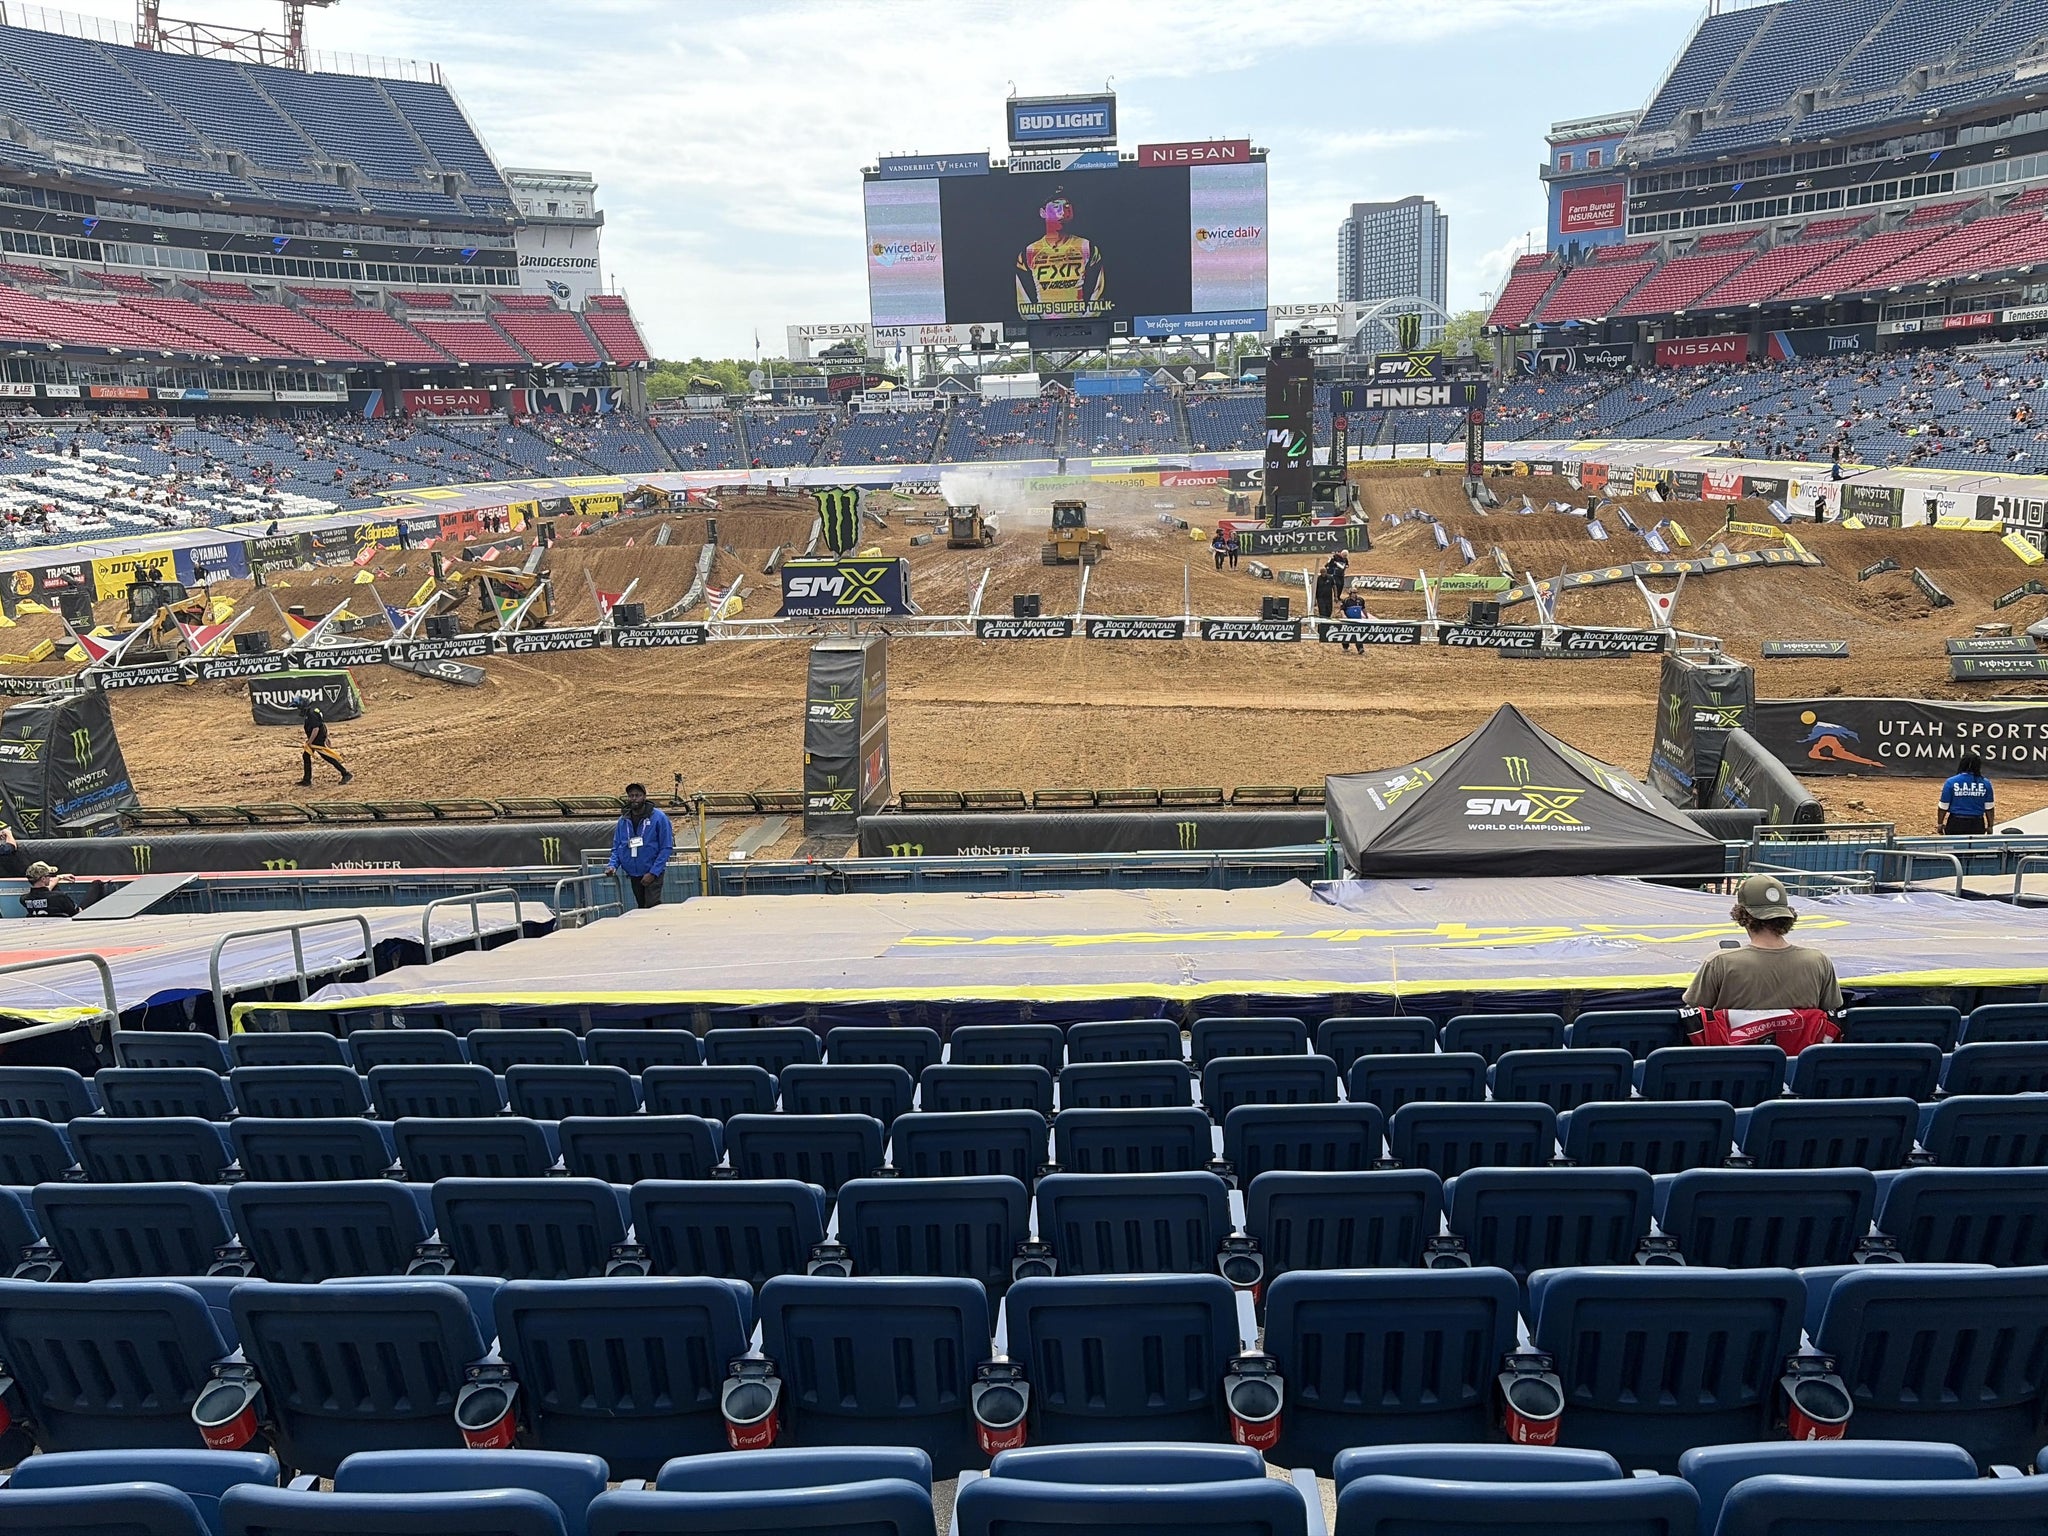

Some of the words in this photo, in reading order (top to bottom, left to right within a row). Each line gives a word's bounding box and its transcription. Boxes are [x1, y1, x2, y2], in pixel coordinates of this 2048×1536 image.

[1019, 115, 1055, 130] BUD
[1056, 112, 1104, 128] LIGHT
[1153, 146, 1235, 161] NISSAN
[888, 163, 935, 172] VANDERBILT
[949, 161, 978, 169] HEALTH
[1010, 157, 1061, 172] Pinnacle
[1568, 206, 1588, 214] Farm
[1590, 202, 1616, 212] Bureau
[1630, 201, 1646, 209] 11:57
[1568, 210, 1615, 222] INSURANCE
[1200, 226, 1262, 240] twicedaily
[878, 241, 936, 254] twicedaily
[520, 255, 598, 268] BRIDGESTONE
[1038, 263, 1082, 280] FXR
[1020, 303, 1053, 314] WHO'S
[1054, 302, 1086, 312] SUPER
[1276, 304, 1344, 315] NISSAN
[800, 325, 865, 336] NISSAN
[1156, 318, 1180, 332] Kroger
[1184, 320, 1203, 328] FRESH
[876, 328, 906, 338] MARS
[1828, 334, 1860, 350] TITANS
[1668, 342, 1736, 356] NISSAN
[1596, 350, 1626, 368] Kroger
[1378, 356, 1435, 378] SMX
[415, 396, 480, 405] NISSAN
[1366, 386, 1450, 408] FINISH
[1177, 477, 1218, 486] HOND
[1790, 480, 1838, 500] twicedaily
[1853, 486, 1890, 499] MONSTER
[256, 537, 292, 549] MONSTER
[1260, 530, 1338, 545] MONSTER
[198, 546, 228, 558] YAMAHA
[1272, 546, 1326, 554] ENERGY
[2008, 535, 2037, 560] SUZUKI
[46, 566, 81, 578] TRACKER
[110, 556, 168, 575] DUNLOP
[786, 568, 888, 605] SMX
[788, 608, 820, 616] WORLD
[822, 606, 892, 615] CHAMPIONSHIP
[1020, 620, 1064, 628] MOUNTAIN
[1105, 621, 1129, 629] ROCKY
[1130, 620, 1176, 628] MOUNTAIN
[1222, 622, 1248, 630] ROCKY
[1250, 622, 1294, 631] MOUNTAIN
[1342, 624, 1367, 633] ROCKY
[1368, 624, 1414, 634] MOUNTAIN
[524, 634, 548, 642] ROCKY
[550, 632, 592, 640] MOUNTAIN
[630, 629, 652, 637] ROCKY
[654, 628, 698, 636] MOUNTAIN
[1462, 628, 1487, 636] ROCKY
[1489, 628, 1536, 638] MOUNTAIN
[1583, 631, 1608, 640] ROCKY
[1612, 632, 1658, 642] MOUNTAIN
[419, 642, 442, 650] ROCKY
[443, 639, 486, 648] MOUNTAIN
[1783, 642, 1828, 650] MONSTER
[316, 651, 338, 660] ROCKY
[340, 647, 381, 658] MOUNTAIN
[214, 660, 238, 669] ROCKY
[240, 656, 280, 667] MOUNTAIN
[1979, 660, 2034, 668] MONSTER
[112, 670, 136, 680] ROCKY
[138, 666, 178, 677] MOUNTAIN
[252, 686, 323, 704] TRIUMPH
[810, 702, 855, 719] SMX
[1694, 710, 1742, 726] SMX
[1879, 720, 1943, 738] UTAH
[1957, 722, 2048, 740] SPORTS
[0, 744, 42, 760] SMX
[1878, 742, 2048, 762] COMMISSION
[68, 768, 108, 789] MONSTER
[1953, 782, 1987, 792] S.A.F.E.
[55, 780, 128, 816] SUPERCROSS
[808, 793, 854, 810] SMX
[72, 798, 116, 820] CHAMPIONSHIP
[1464, 792, 1583, 824] SMX
[1508, 824, 1591, 832] CHAMPIONSHIP
[958, 845, 1031, 856] MONSTER
[332, 860, 402, 870] MONSTER
[739, 1432, 766, 1445] Coca-Cola
[991, 1437, 1018, 1448] Coca-Cola
[1247, 1430, 1275, 1442] Coca-Cola
